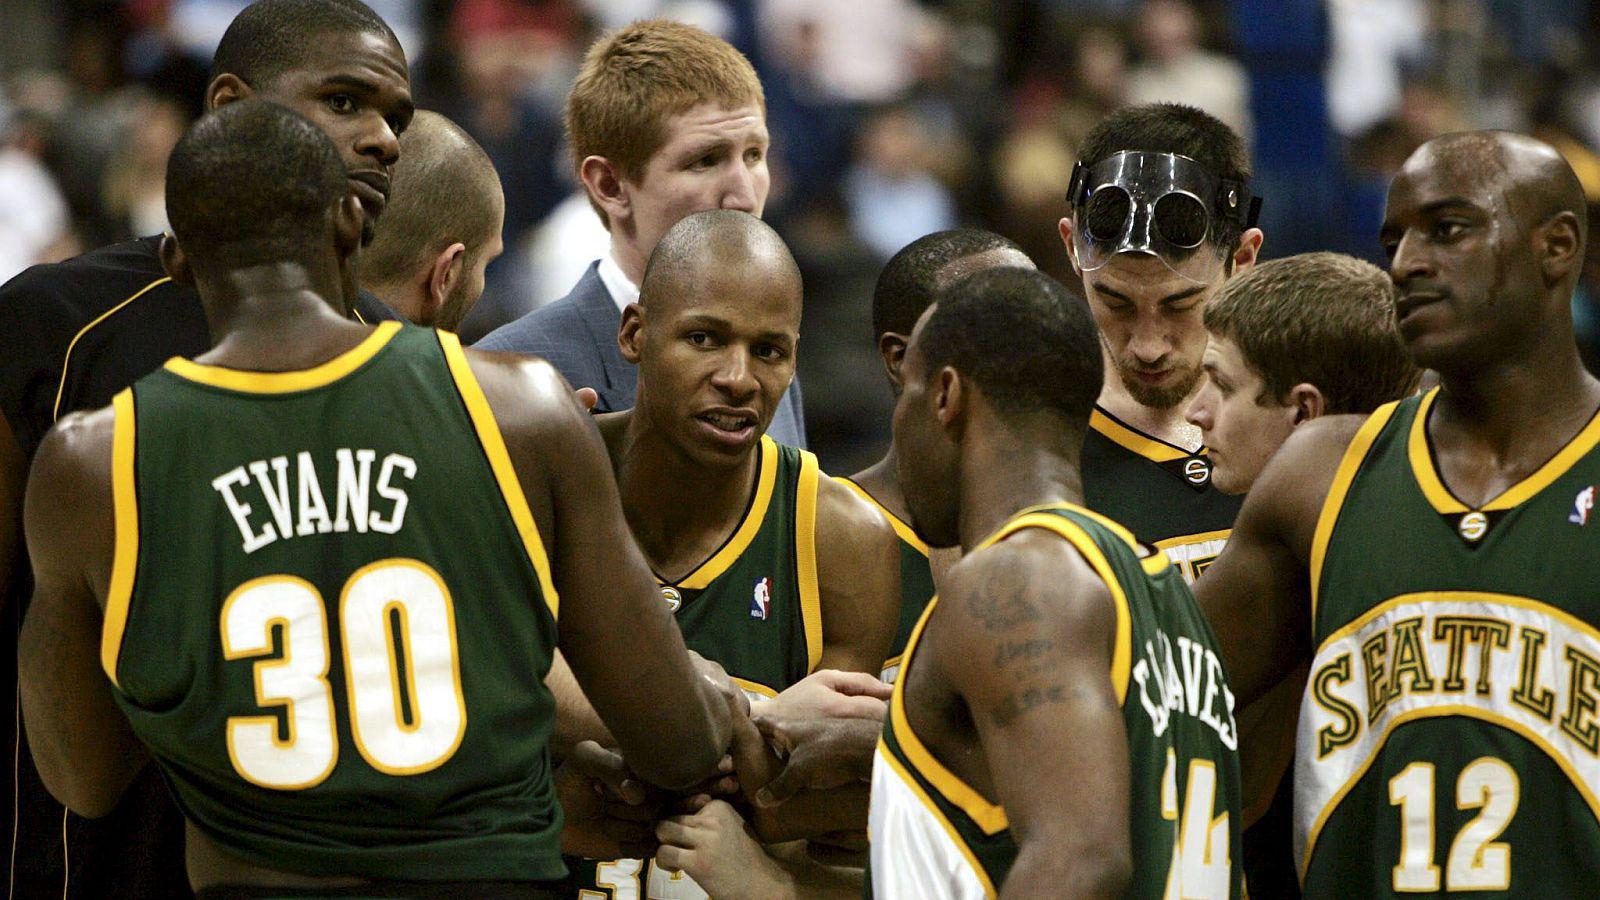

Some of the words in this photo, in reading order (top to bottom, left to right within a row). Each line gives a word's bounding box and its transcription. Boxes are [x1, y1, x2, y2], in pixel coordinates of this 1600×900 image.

[211, 448, 417, 553] EVANS
[219, 557, 467, 791] 30
[1311, 614, 1600, 760] SEATTLE
[1388, 755, 1520, 893] 12
